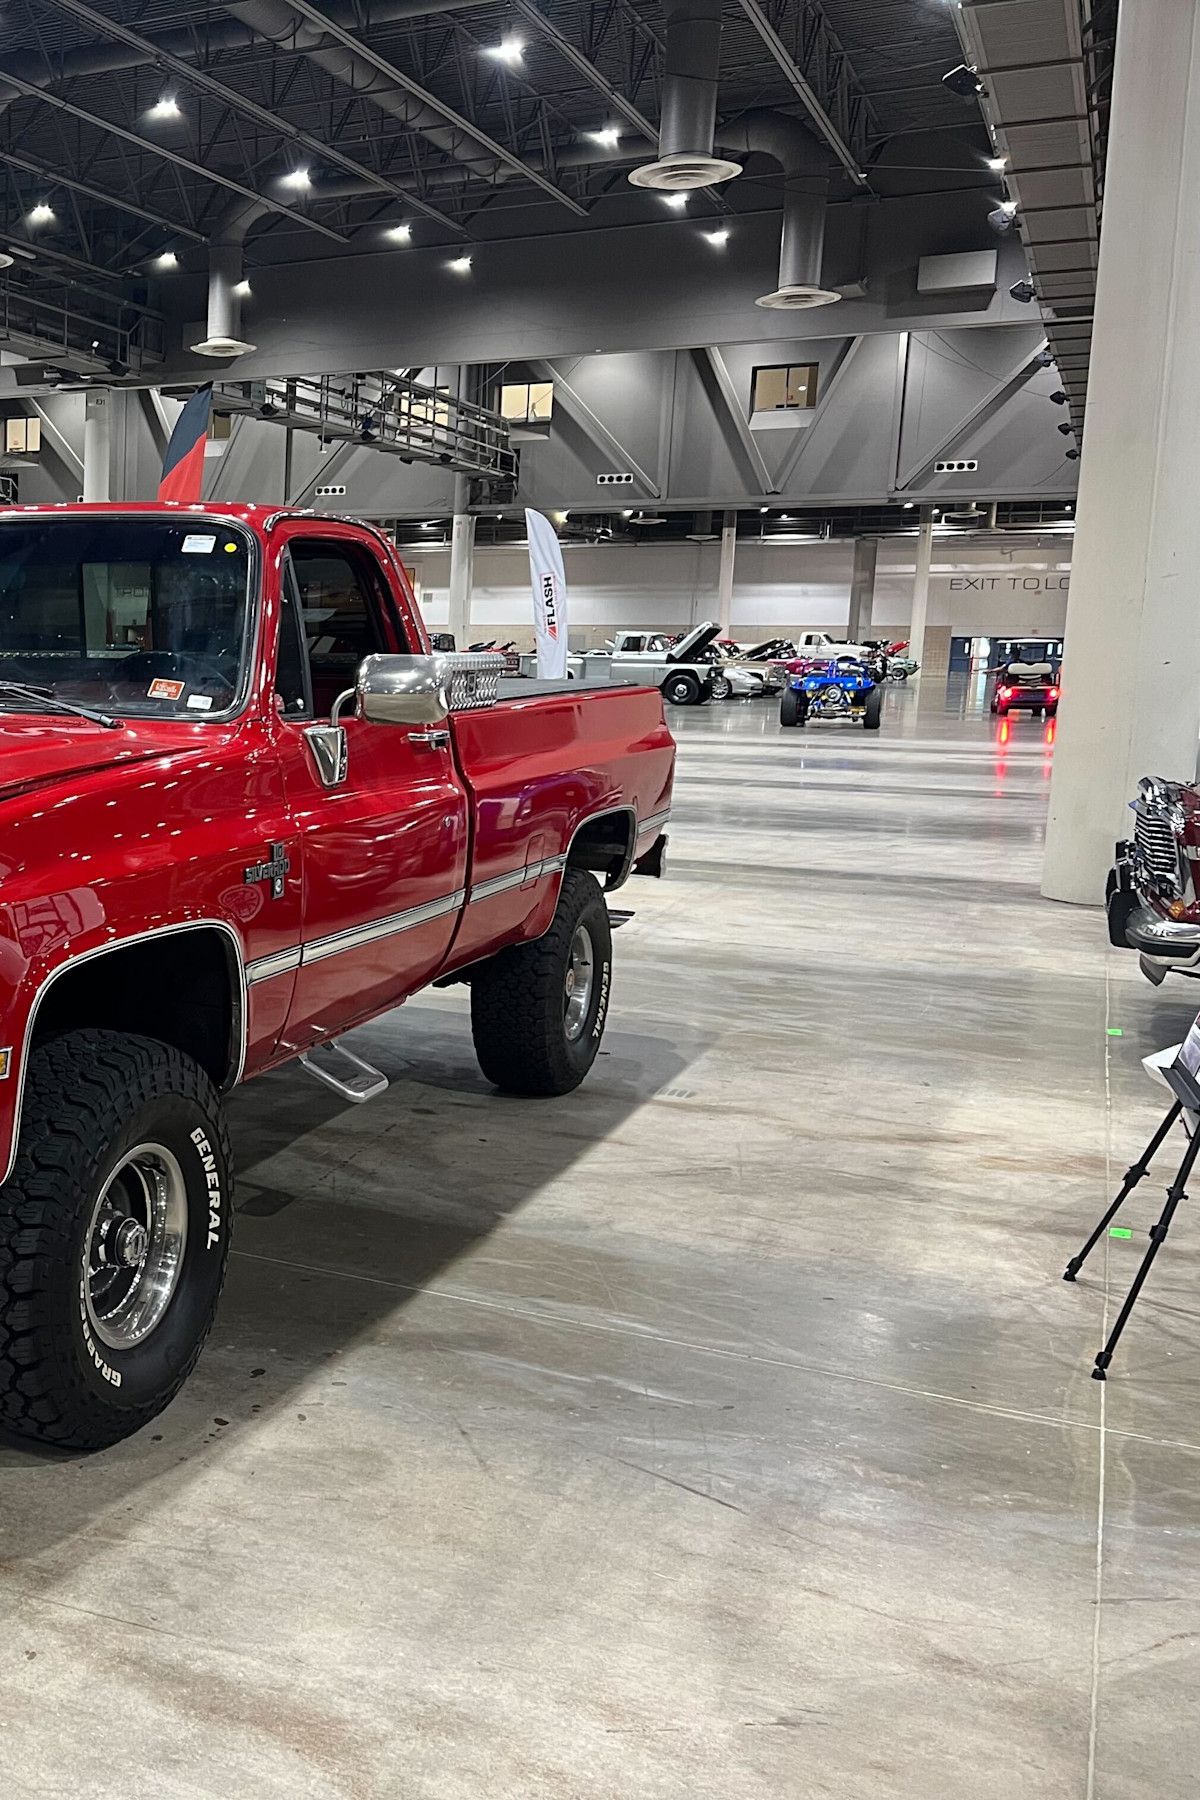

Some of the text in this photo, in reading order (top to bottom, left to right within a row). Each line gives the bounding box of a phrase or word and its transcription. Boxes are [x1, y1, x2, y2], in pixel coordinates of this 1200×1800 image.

[544, 576, 556, 626] FLASH
[950, 578, 1000, 591] EXIT
[1008, 577, 1040, 590] TO
[592, 961, 609, 1037] GENERAL
[190, 1127, 221, 1250] GENERAL
